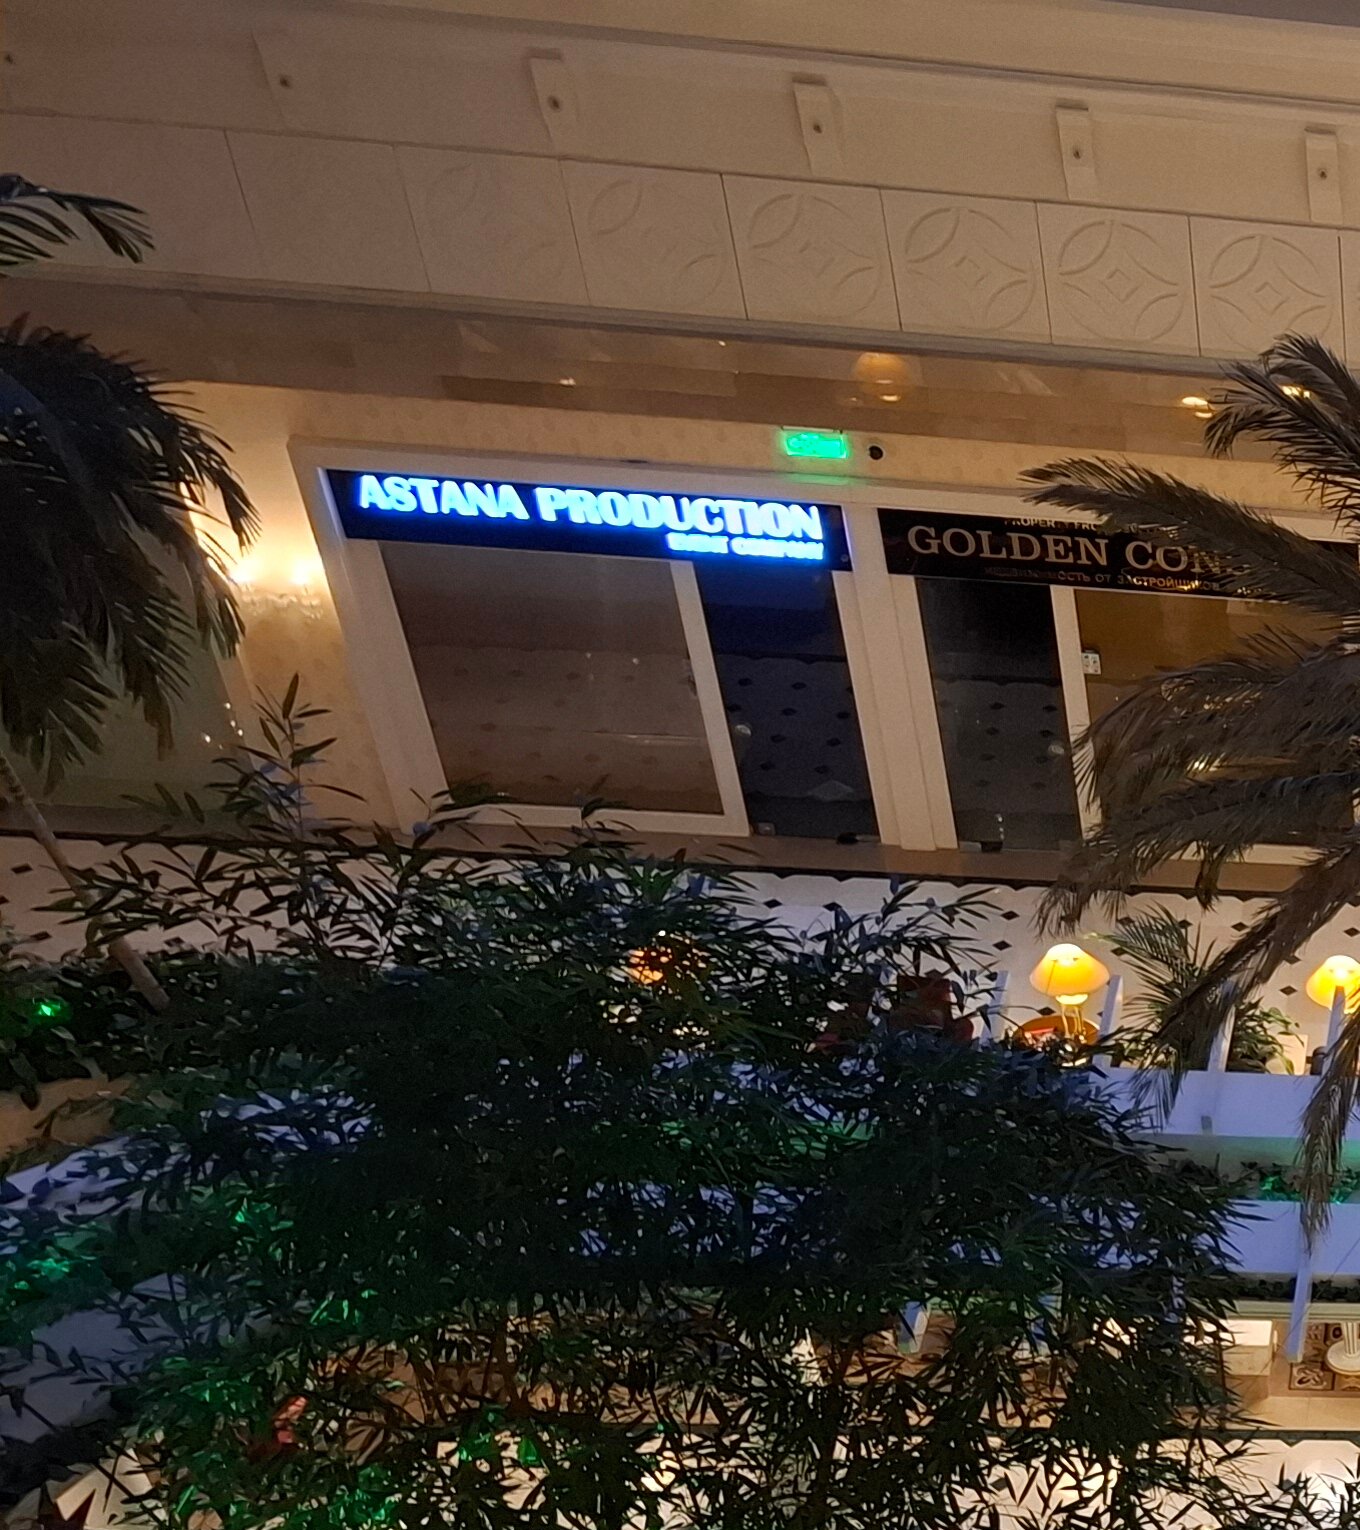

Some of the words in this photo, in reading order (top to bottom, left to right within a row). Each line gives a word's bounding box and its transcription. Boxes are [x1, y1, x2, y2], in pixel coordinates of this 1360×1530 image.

[359, 474, 530, 520] ASTANA
[533, 486, 824, 540] PRODUCTION
[907, 525, 1109, 566] GOLDEN
